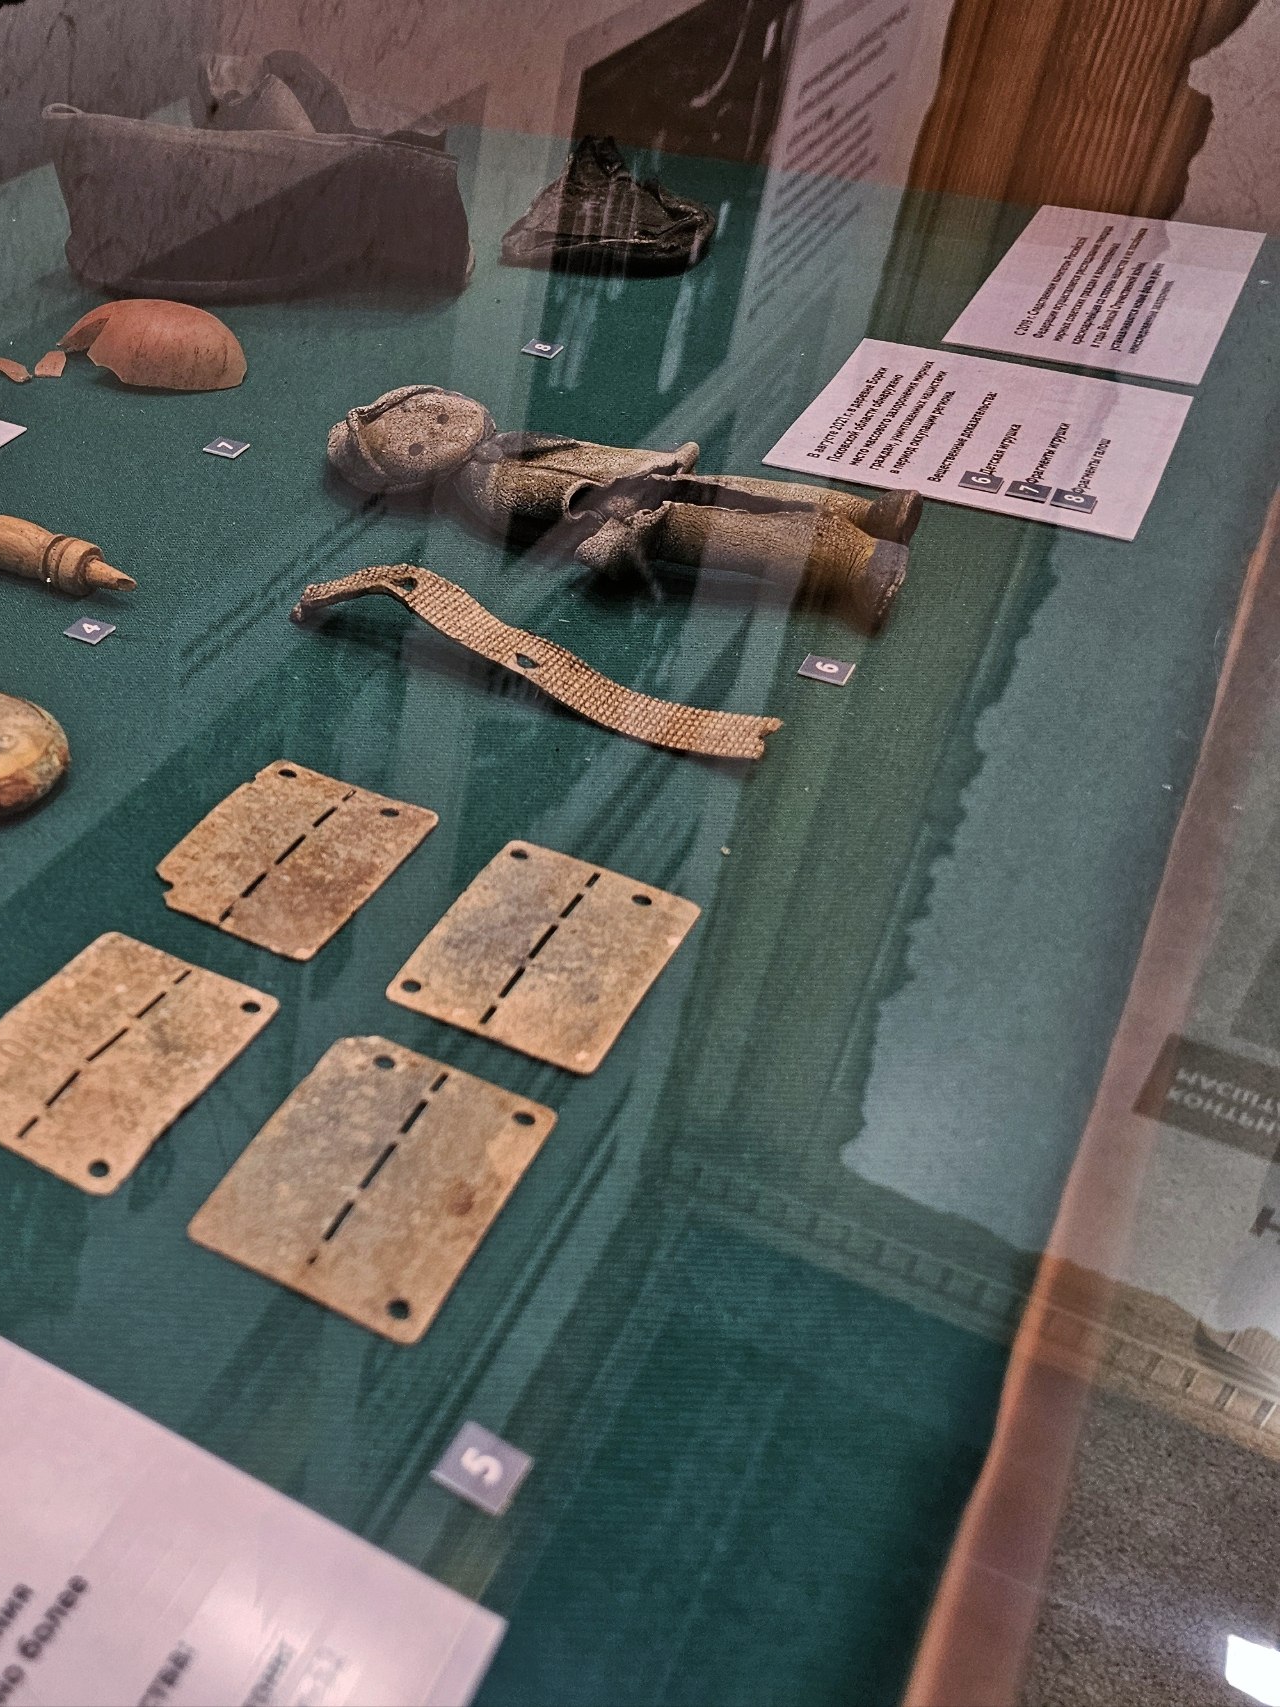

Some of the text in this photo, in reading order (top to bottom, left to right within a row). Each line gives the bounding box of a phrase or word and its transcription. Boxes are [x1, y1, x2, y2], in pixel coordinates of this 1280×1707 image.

[534, 342, 552, 352] 8
[216, 441, 234, 450] 7
[814, 430, 839, 453] августе
[828, 416, 851, 431] 2021
[850, 384, 876, 409] деревне
[865, 366, 888, 385] Борки
[825, 374, 904, 463] Псковской области обнаружено
[848, 360, 935, 467] место массового захоронения мирных
[868, 371, 947, 470] граждан, уничтоженных нацистами
[892, 446, 919, 470] период
[909, 414, 939, 447] оккупации
[931, 390, 956, 416] региона.
[926, 391, 998, 483] Вещественные доказательства:
[971, 423, 1022, 484] 6 Детская игрушка
[1019, 422, 1070, 494] 7 Фрагменты игрушки
[1064, 438, 1112, 503] 8 Фрагменты галош
[81, 622, 103, 635] 4
[814, 660, 839, 675] 6
[459, 1446, 505, 1487] 5
[15, 1575, 90, 1664] более
